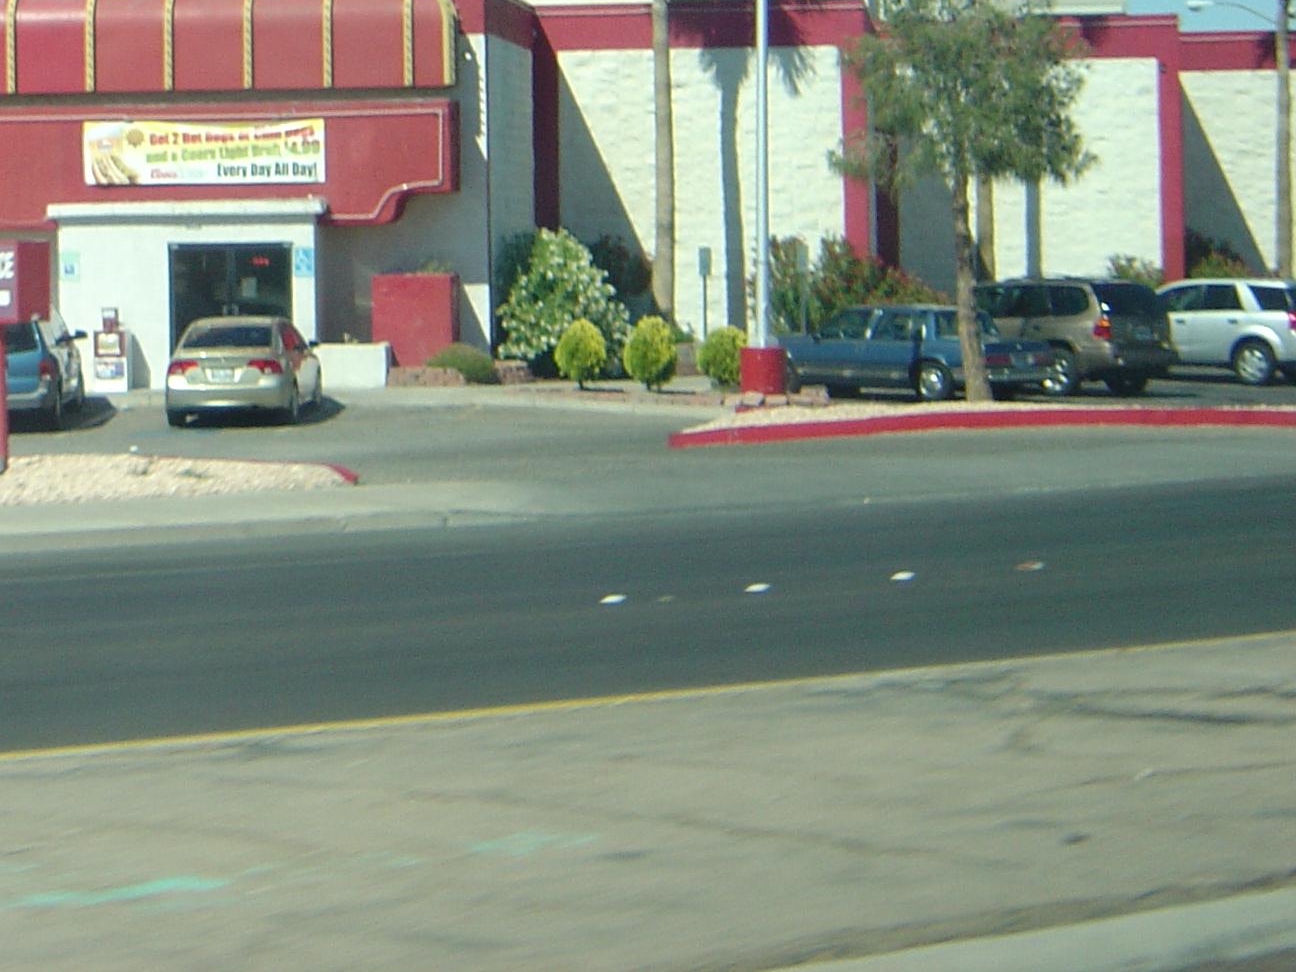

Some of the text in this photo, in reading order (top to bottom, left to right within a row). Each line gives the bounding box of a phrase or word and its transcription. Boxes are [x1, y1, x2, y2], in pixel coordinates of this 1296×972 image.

[217, 163, 247, 178] Every
[250, 162, 272, 178] Day
[275, 162, 289, 177] All
